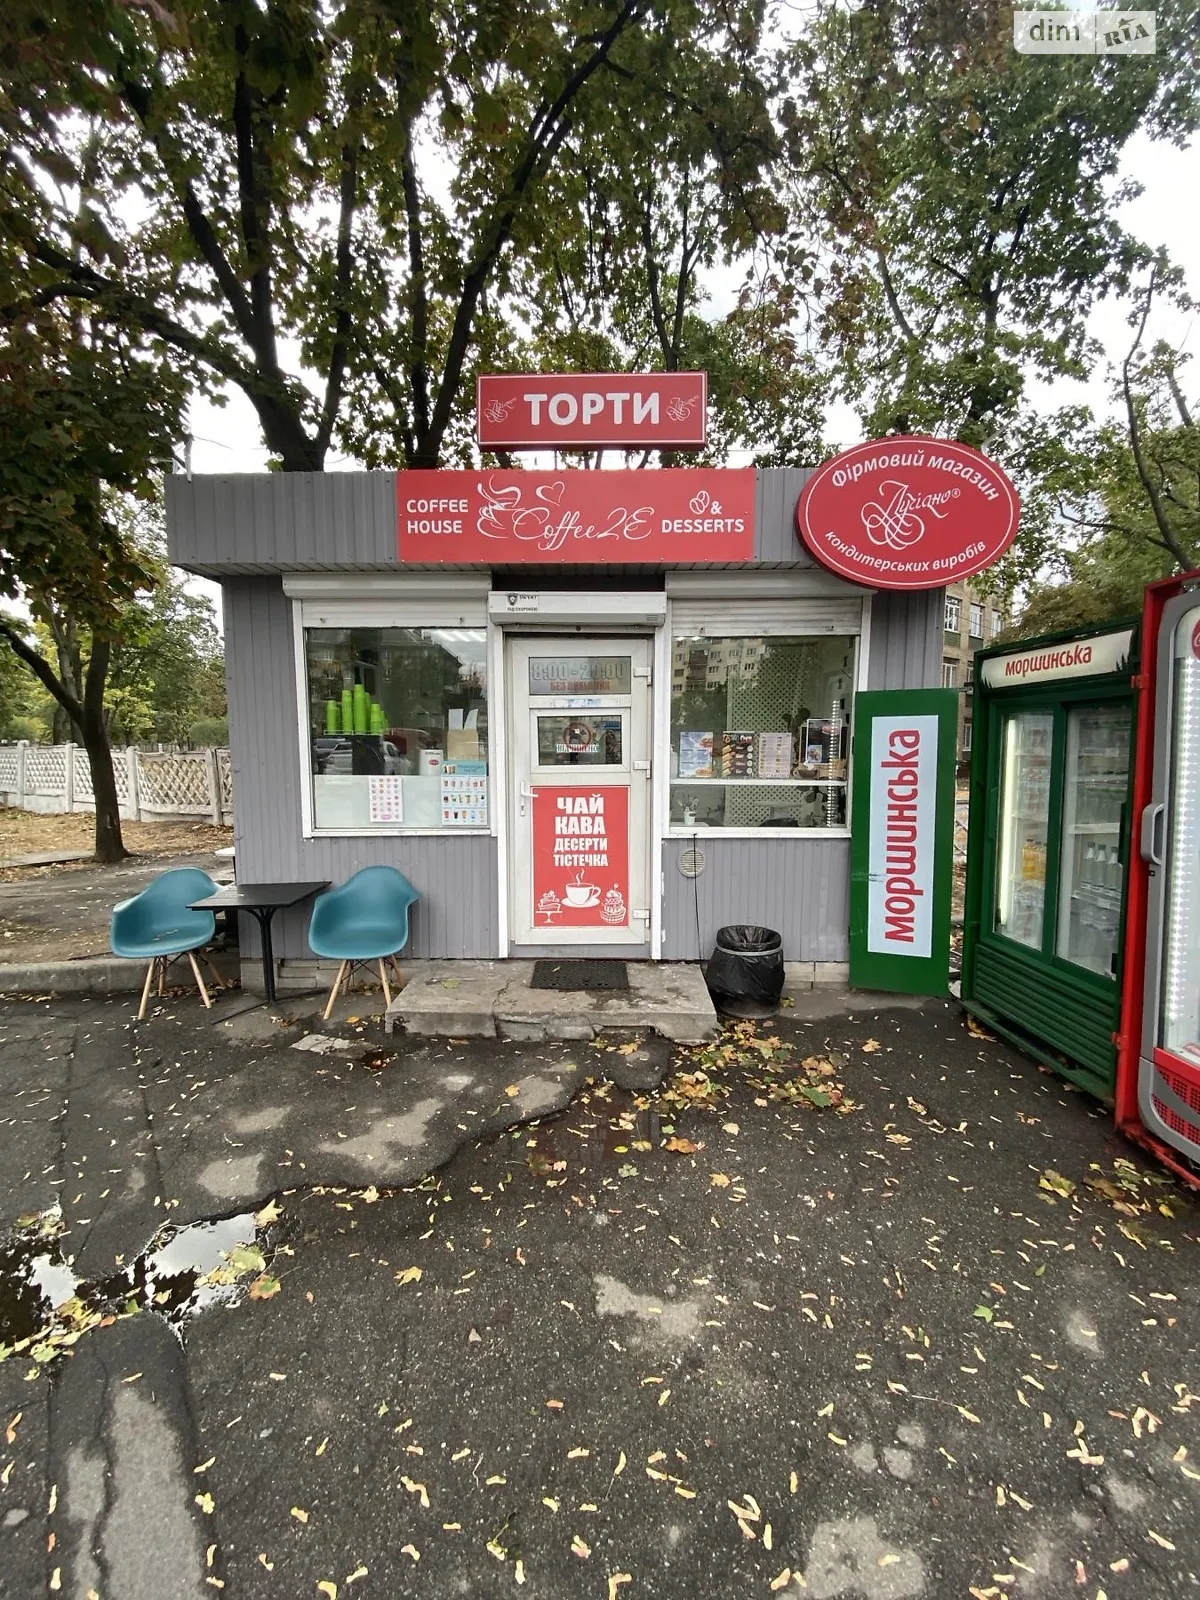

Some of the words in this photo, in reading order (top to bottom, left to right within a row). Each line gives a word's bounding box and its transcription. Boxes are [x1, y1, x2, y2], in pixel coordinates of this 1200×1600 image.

[523, 392, 660, 426] ТОРТИ
[831, 450, 924, 487] Фірмовий
[928, 455, 1000, 501] магазин
[406, 499, 469, 513] COFFEE
[710, 502, 722, 514] &
[407, 520, 463, 534] HOUSE
[661, 519, 745, 533] DESSERTS
[825, 530, 930, 573] кондитерських
[932, 541, 987, 570] виробів
[1004, 644, 1093, 678] моршинська
[556, 793, 605, 814] ЧАЙ
[555, 816, 606, 835] КАВА
[553, 837, 608, 853] ДЕСЕРТИ
[880, 729, 924, 943] моршинська
[552, 854, 609, 867] ТІСТЕЧКА
